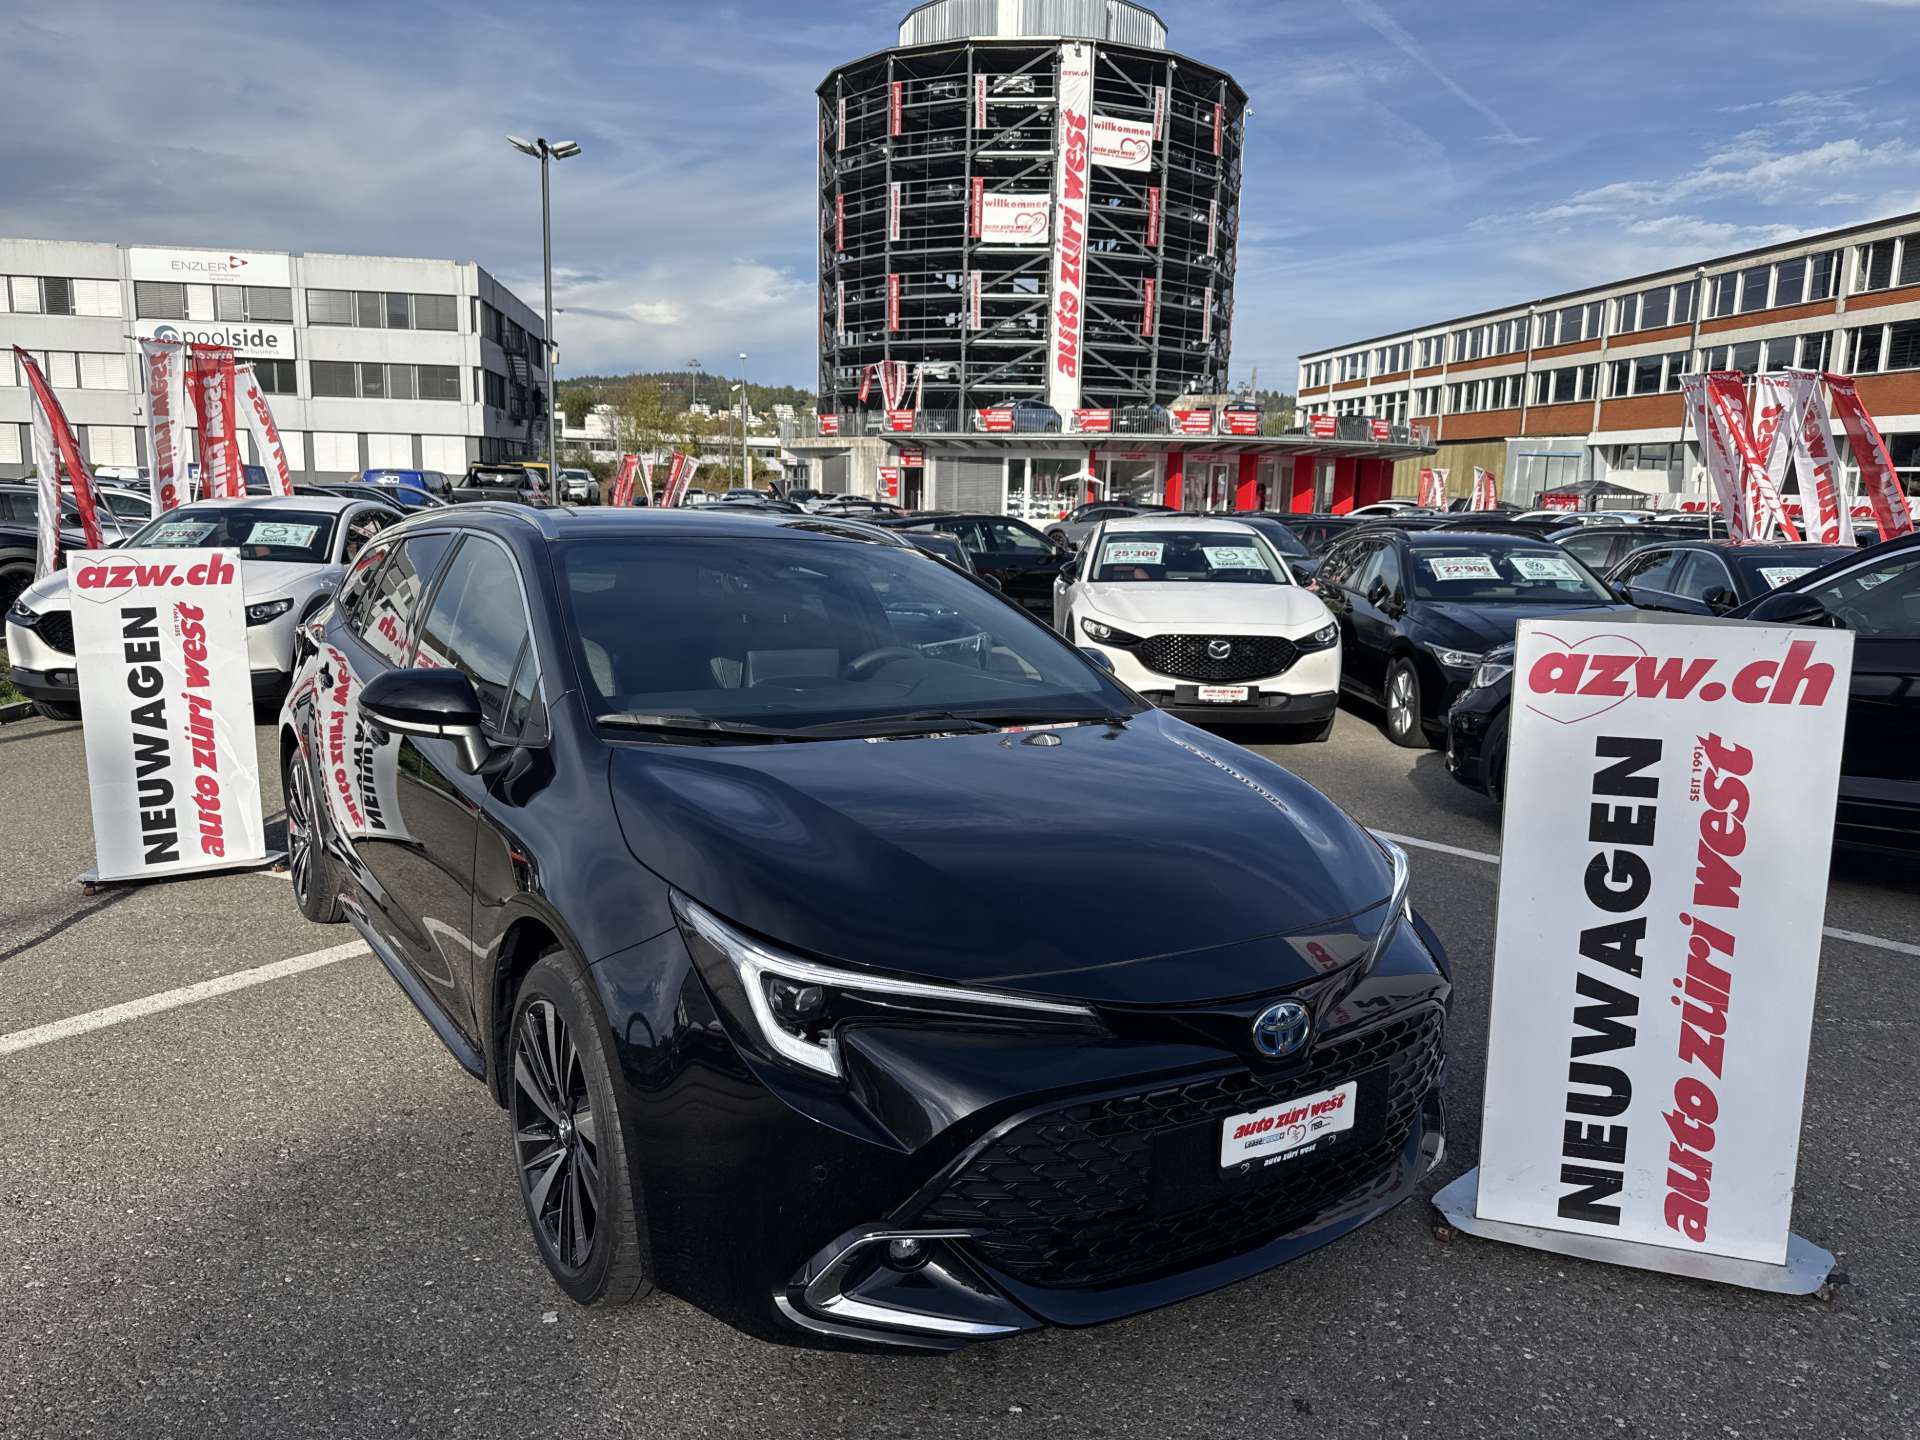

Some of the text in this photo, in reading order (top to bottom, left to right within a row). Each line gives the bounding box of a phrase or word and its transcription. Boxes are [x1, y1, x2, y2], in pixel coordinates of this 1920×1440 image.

[1094, 120, 1151, 136] willkommen
[984, 198, 1048, 209] willkommen
[1055, 108, 1087, 378] auto züri west
[171, 260, 228, 273] ENZLER
[183, 327, 278, 349] poolside
[76, 553, 236, 589] azw.ch
[1114, 549, 1158, 558] 25'300
[1443, 565, 1490, 575] 22'900
[1528, 640, 1835, 707] azw.ch
[120, 606, 180, 866] NEUWAGEN
[174, 600, 225, 858] auto züri west
[1689, 743, 1705, 802] SEIT 1991
[1557, 735, 1663, 1226] NEUWAGEN
[1660, 731, 1754, 1244] auto züri west
[1232, 1092, 1347, 1140] auto züri west
[1263, 1143, 1317, 1167] auto züri west
